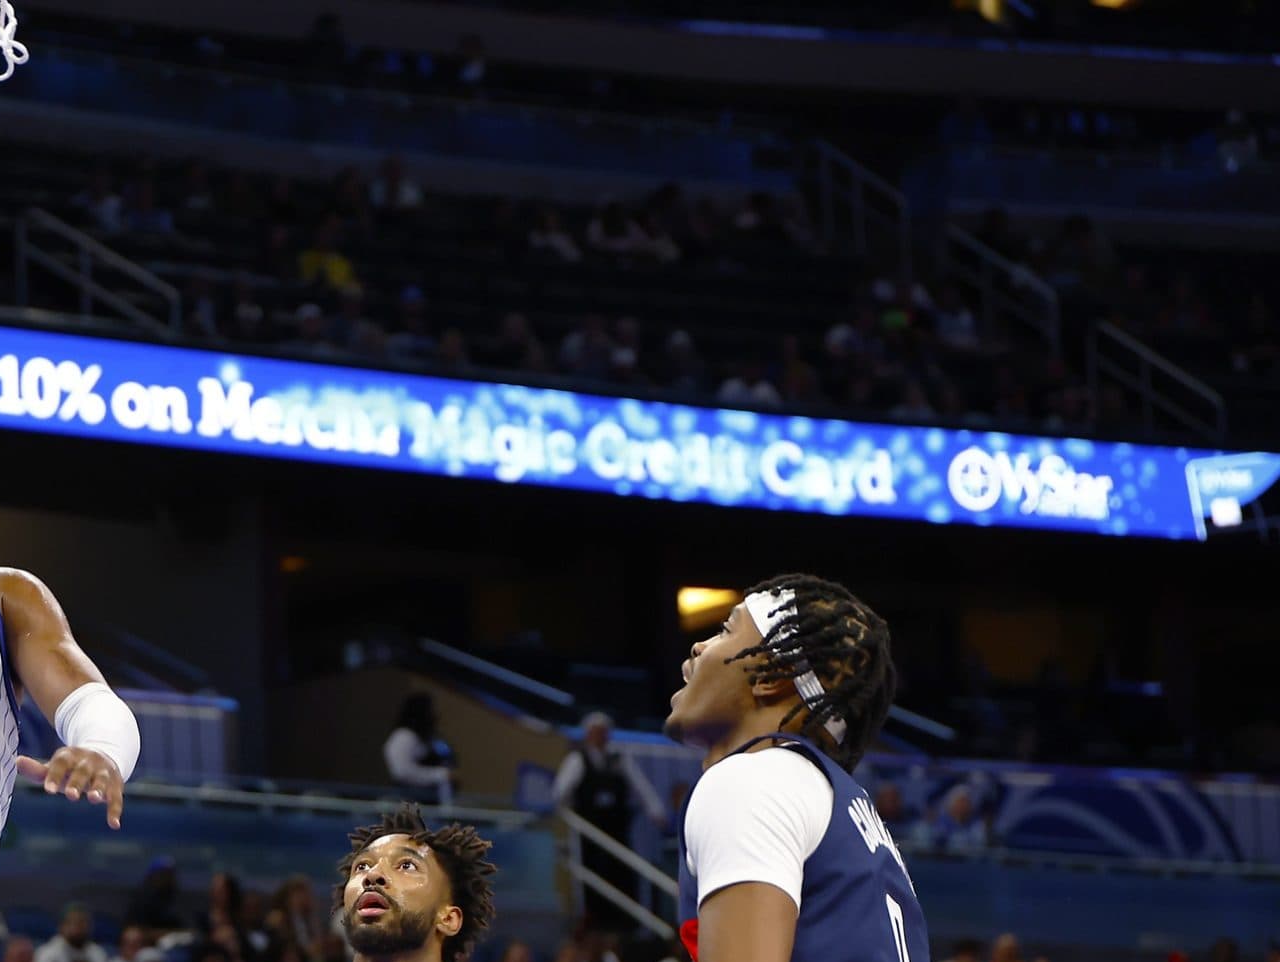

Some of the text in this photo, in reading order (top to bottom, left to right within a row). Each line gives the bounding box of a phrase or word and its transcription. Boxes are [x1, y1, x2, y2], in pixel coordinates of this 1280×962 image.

[111, 381, 193, 434] on
[585, 421, 752, 491] Credit
[760, 440, 897, 505] Card
[993, 450, 1113, 516] VyStar
